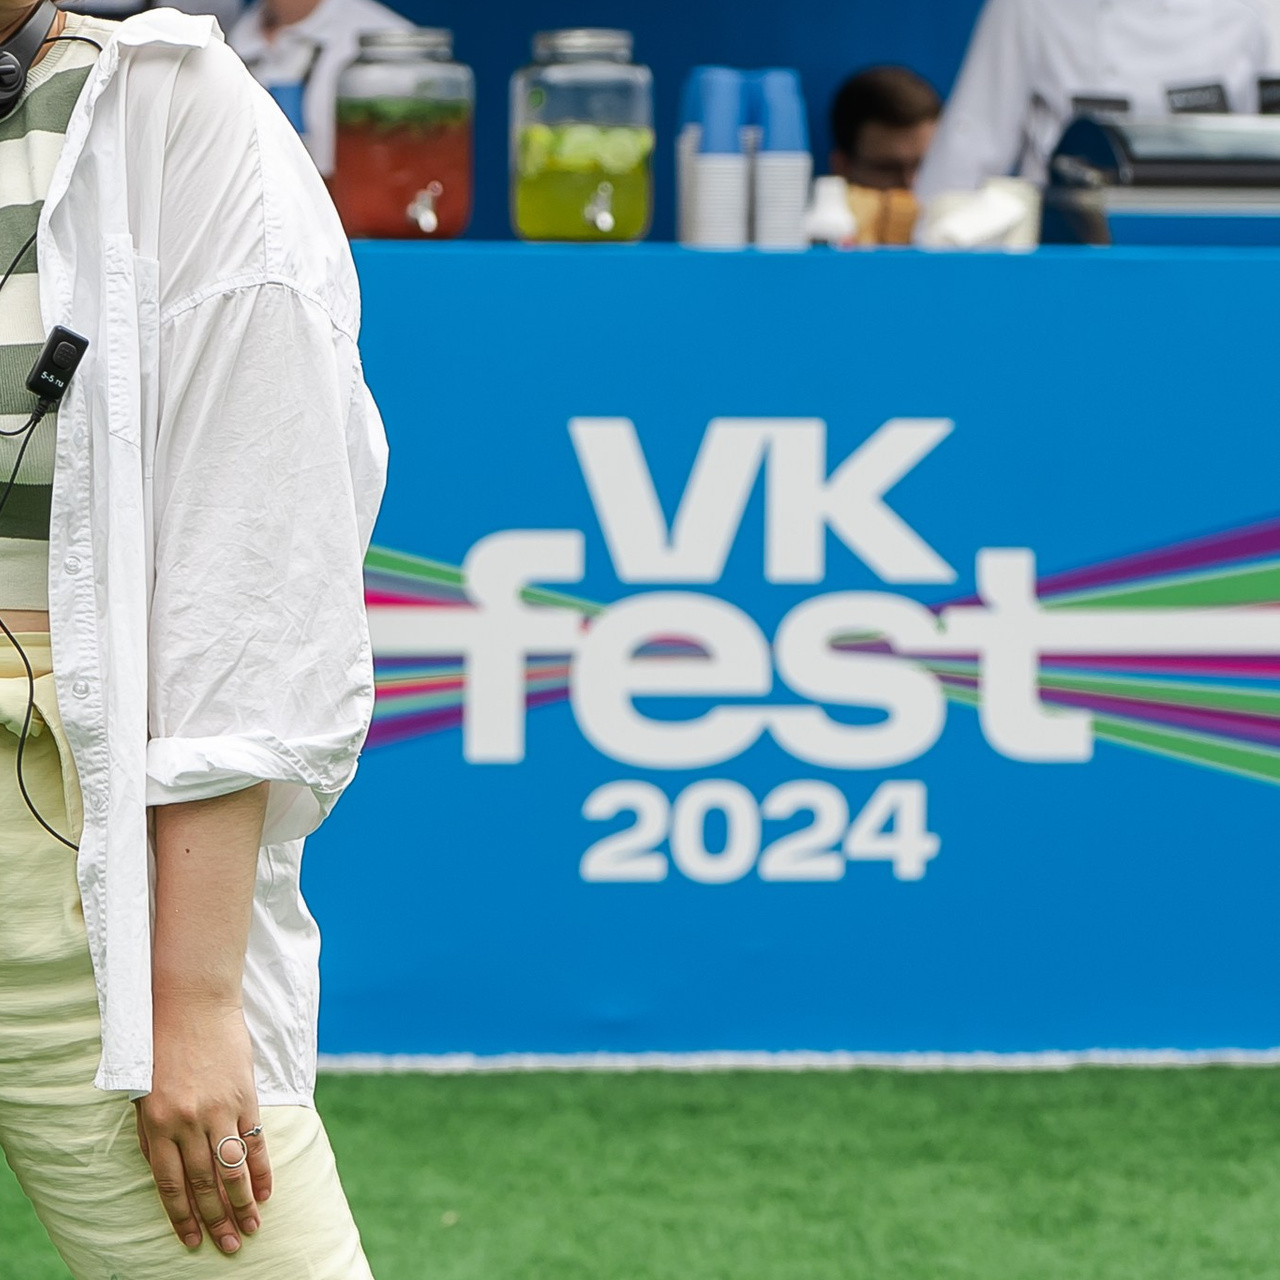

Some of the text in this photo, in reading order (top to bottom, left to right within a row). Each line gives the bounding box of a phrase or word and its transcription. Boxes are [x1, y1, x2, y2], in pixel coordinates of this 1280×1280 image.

[567, 415, 961, 586] VK
[462, 527, 1095, 772] fest
[578, 778, 942, 885] 2024
